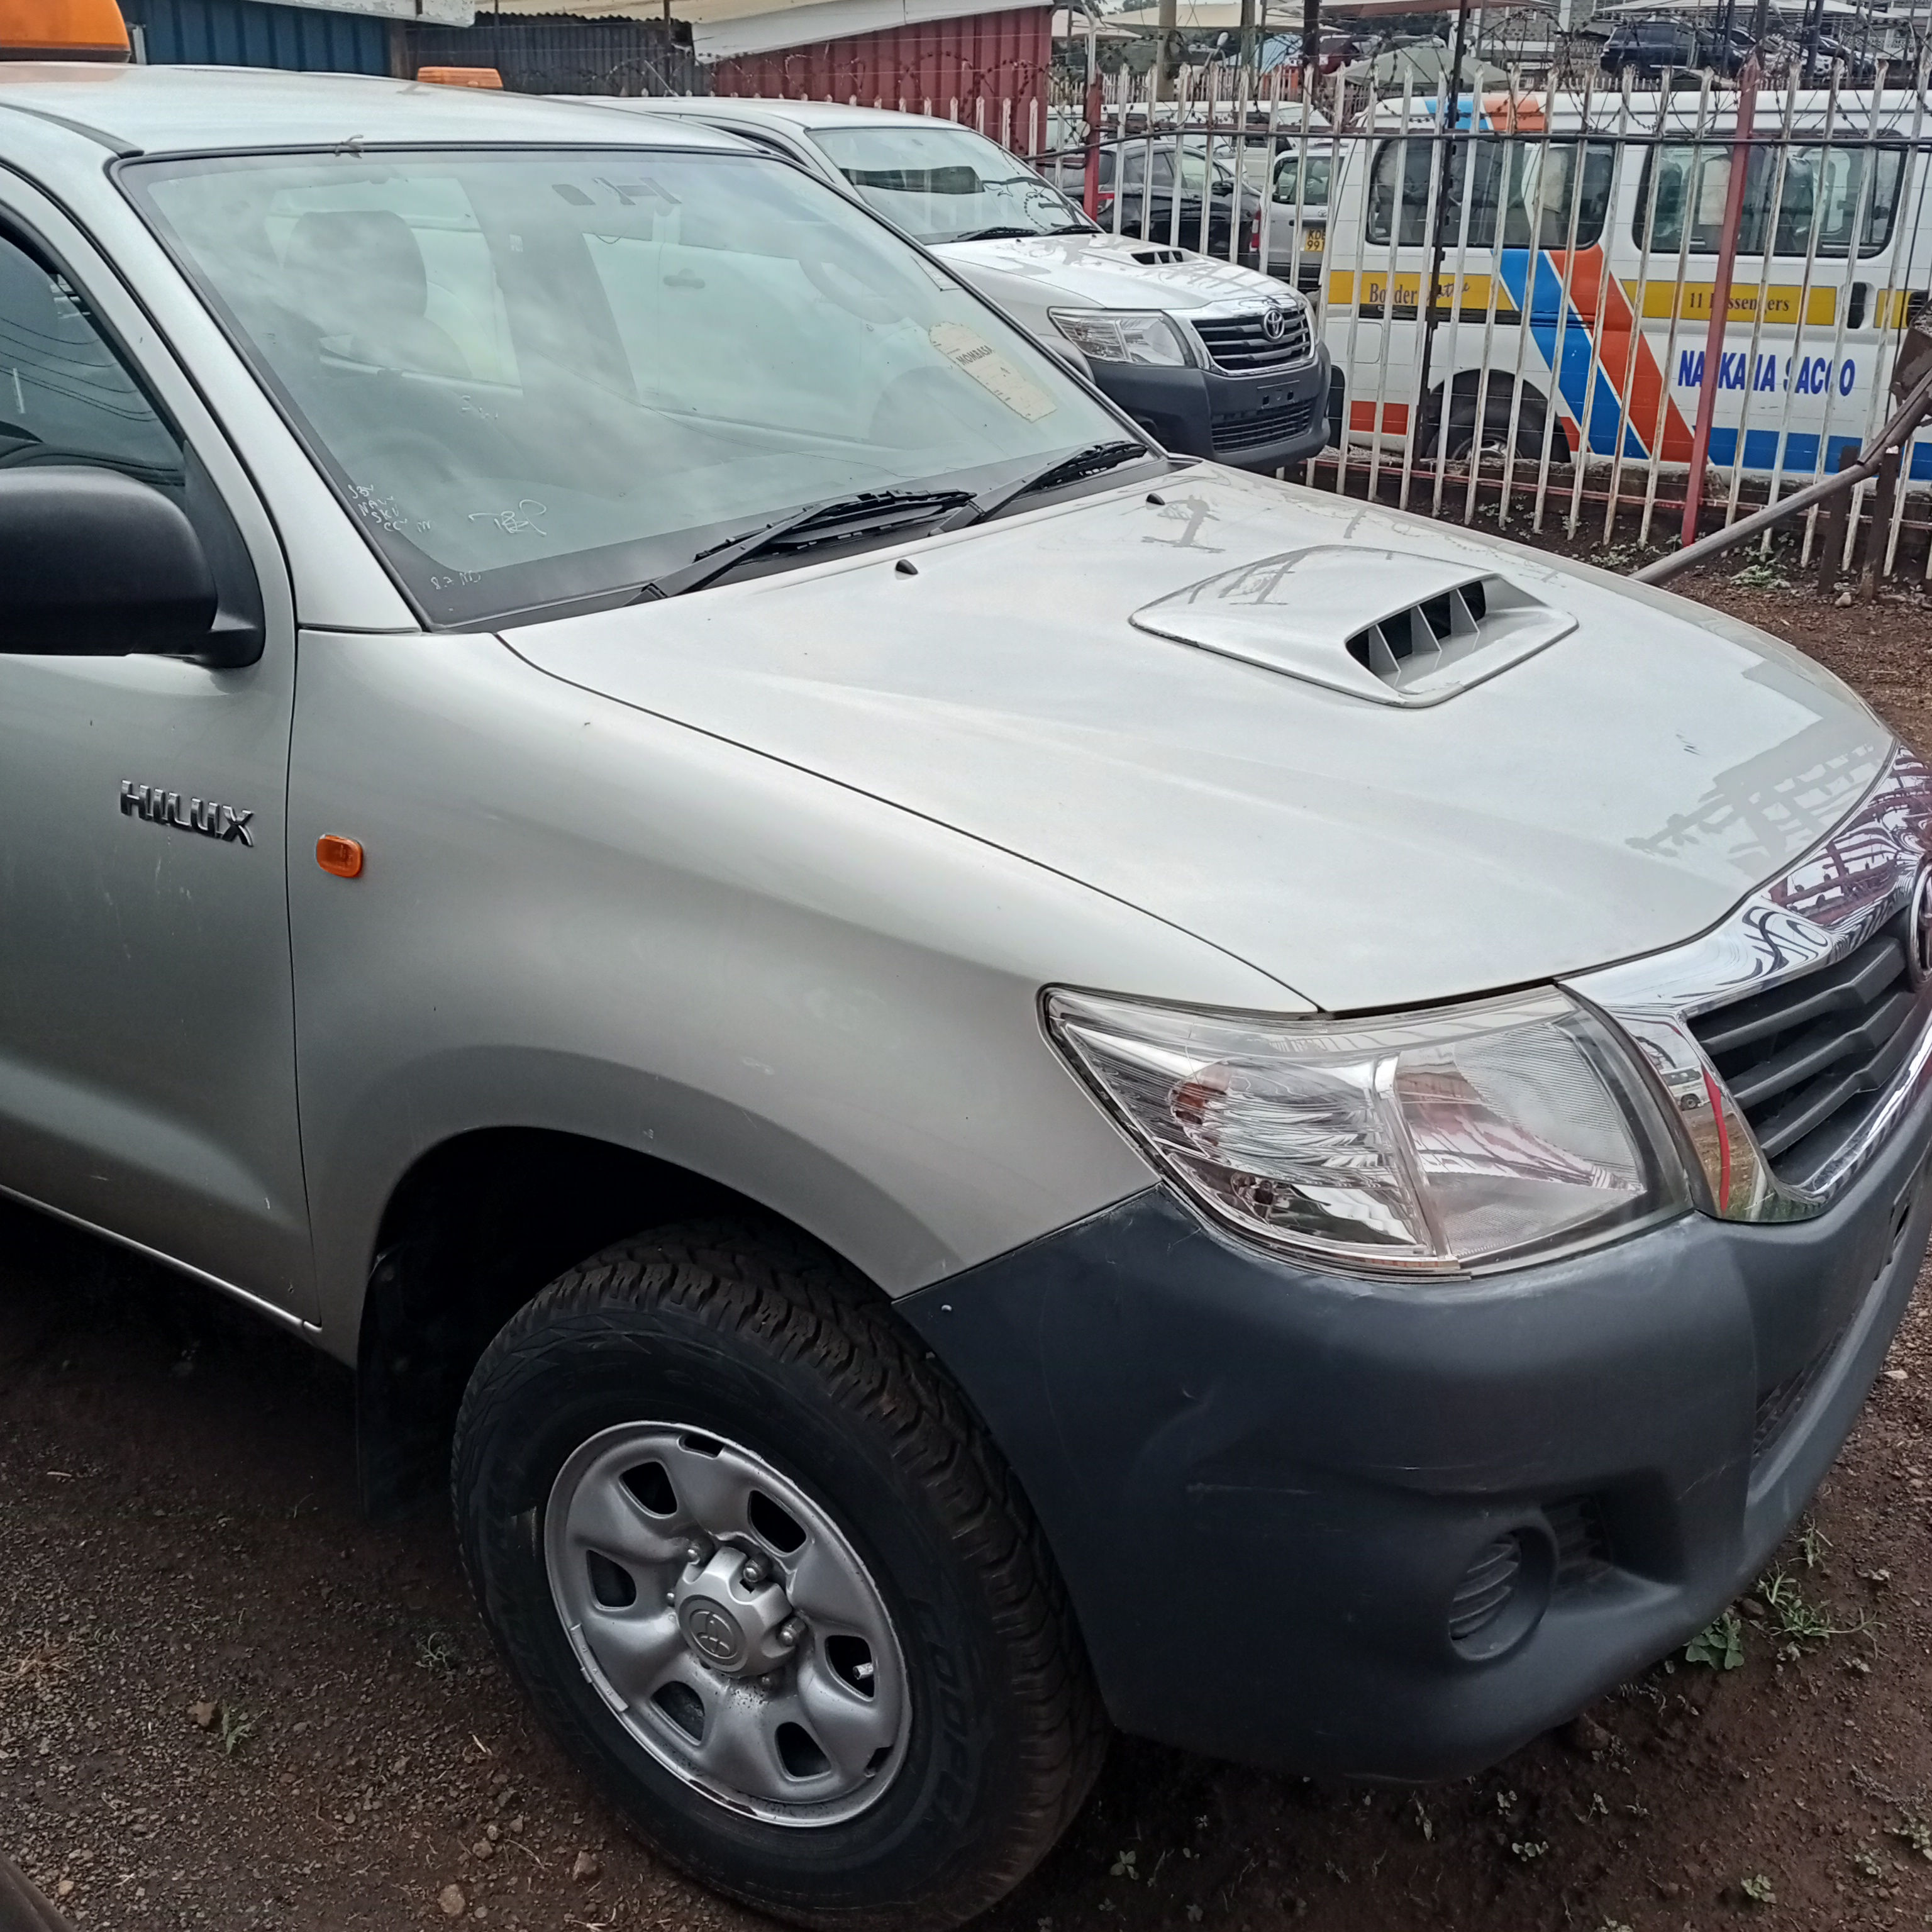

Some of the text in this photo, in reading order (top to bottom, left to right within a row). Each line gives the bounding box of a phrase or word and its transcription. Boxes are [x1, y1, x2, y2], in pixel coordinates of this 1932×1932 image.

[1369, 282, 1418, 304] Boder
[1690, 292, 1790, 315] 11 sseners
[955, 345, 993, 365] MOMBASA
[1677, 350, 1776, 392] NAKAA
[120, 779, 255, 847] HILUX
